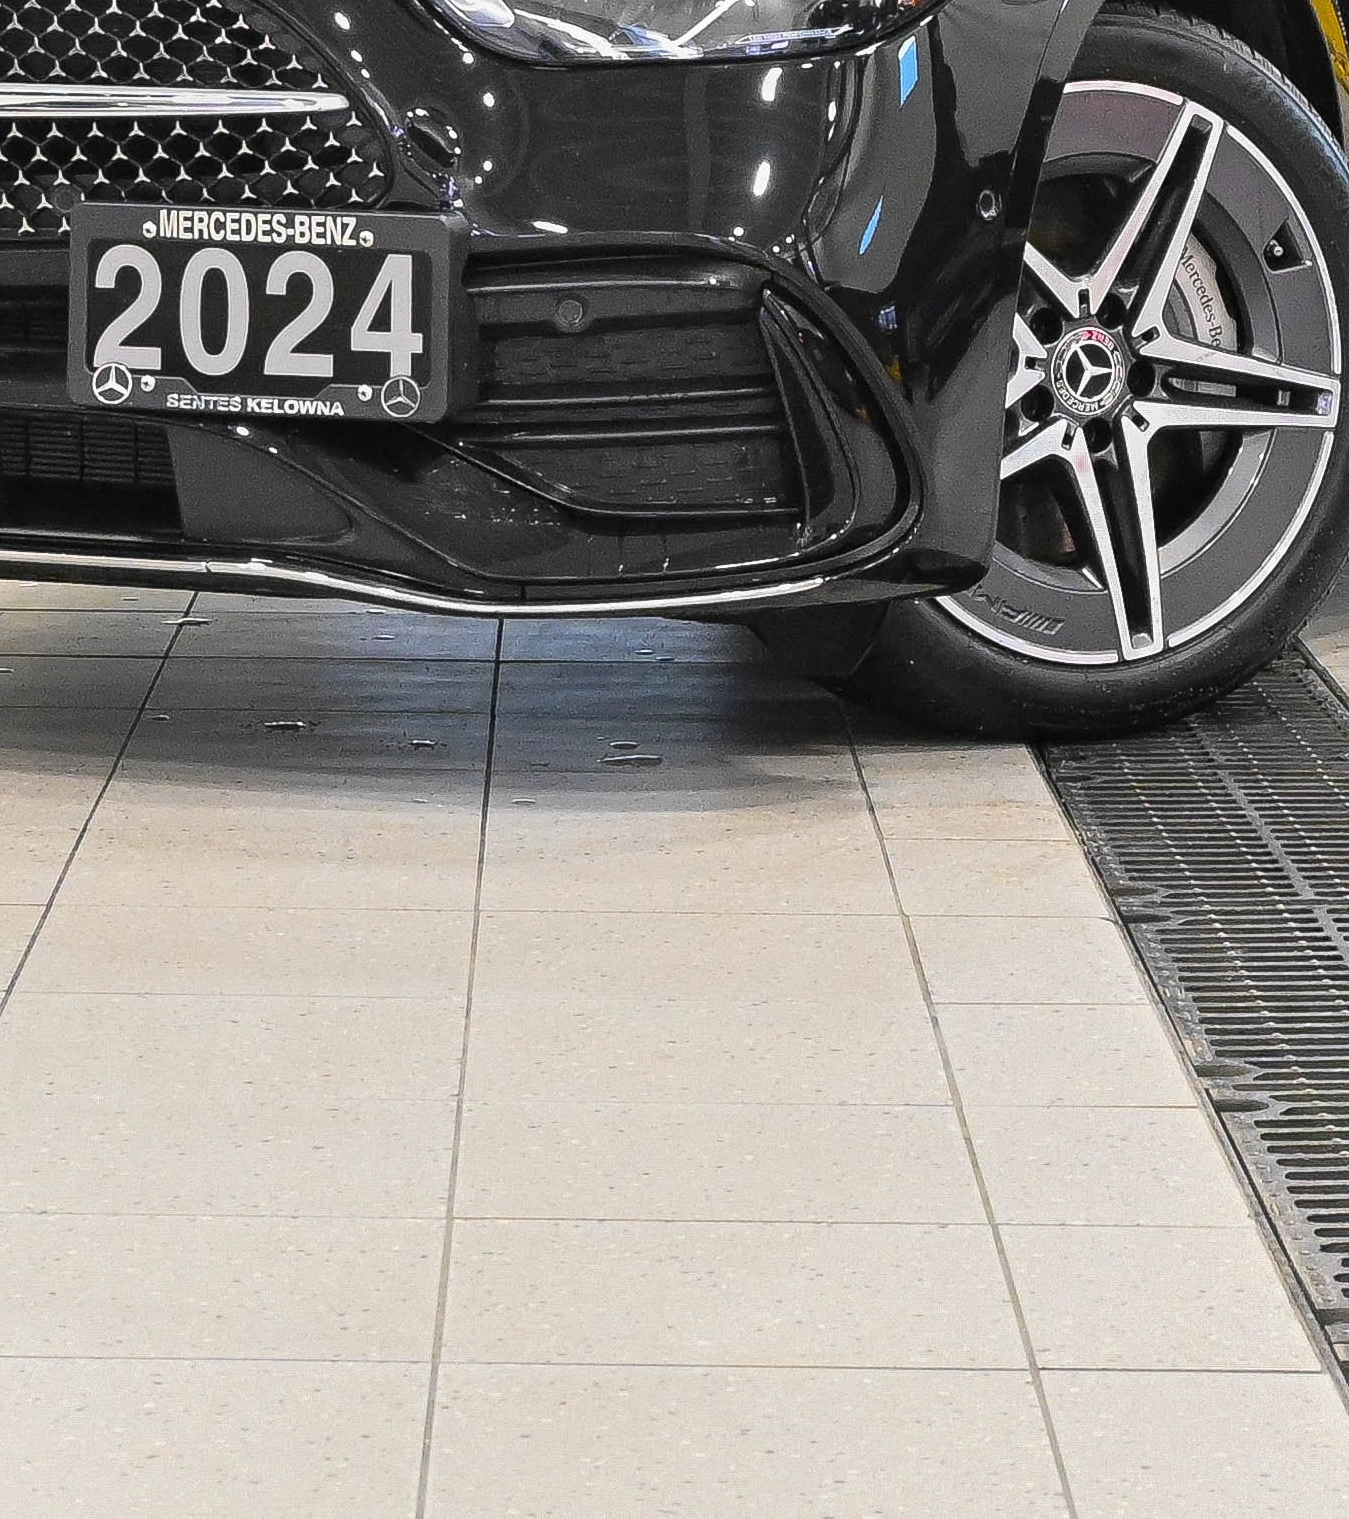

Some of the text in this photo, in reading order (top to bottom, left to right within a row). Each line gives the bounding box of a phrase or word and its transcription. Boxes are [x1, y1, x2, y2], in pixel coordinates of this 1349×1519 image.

[159, 209, 358, 246] MERCEDES-BENZ
[93, 244, 423, 378] 2024
[166, 393, 345, 416] SENTES KELOWNA
